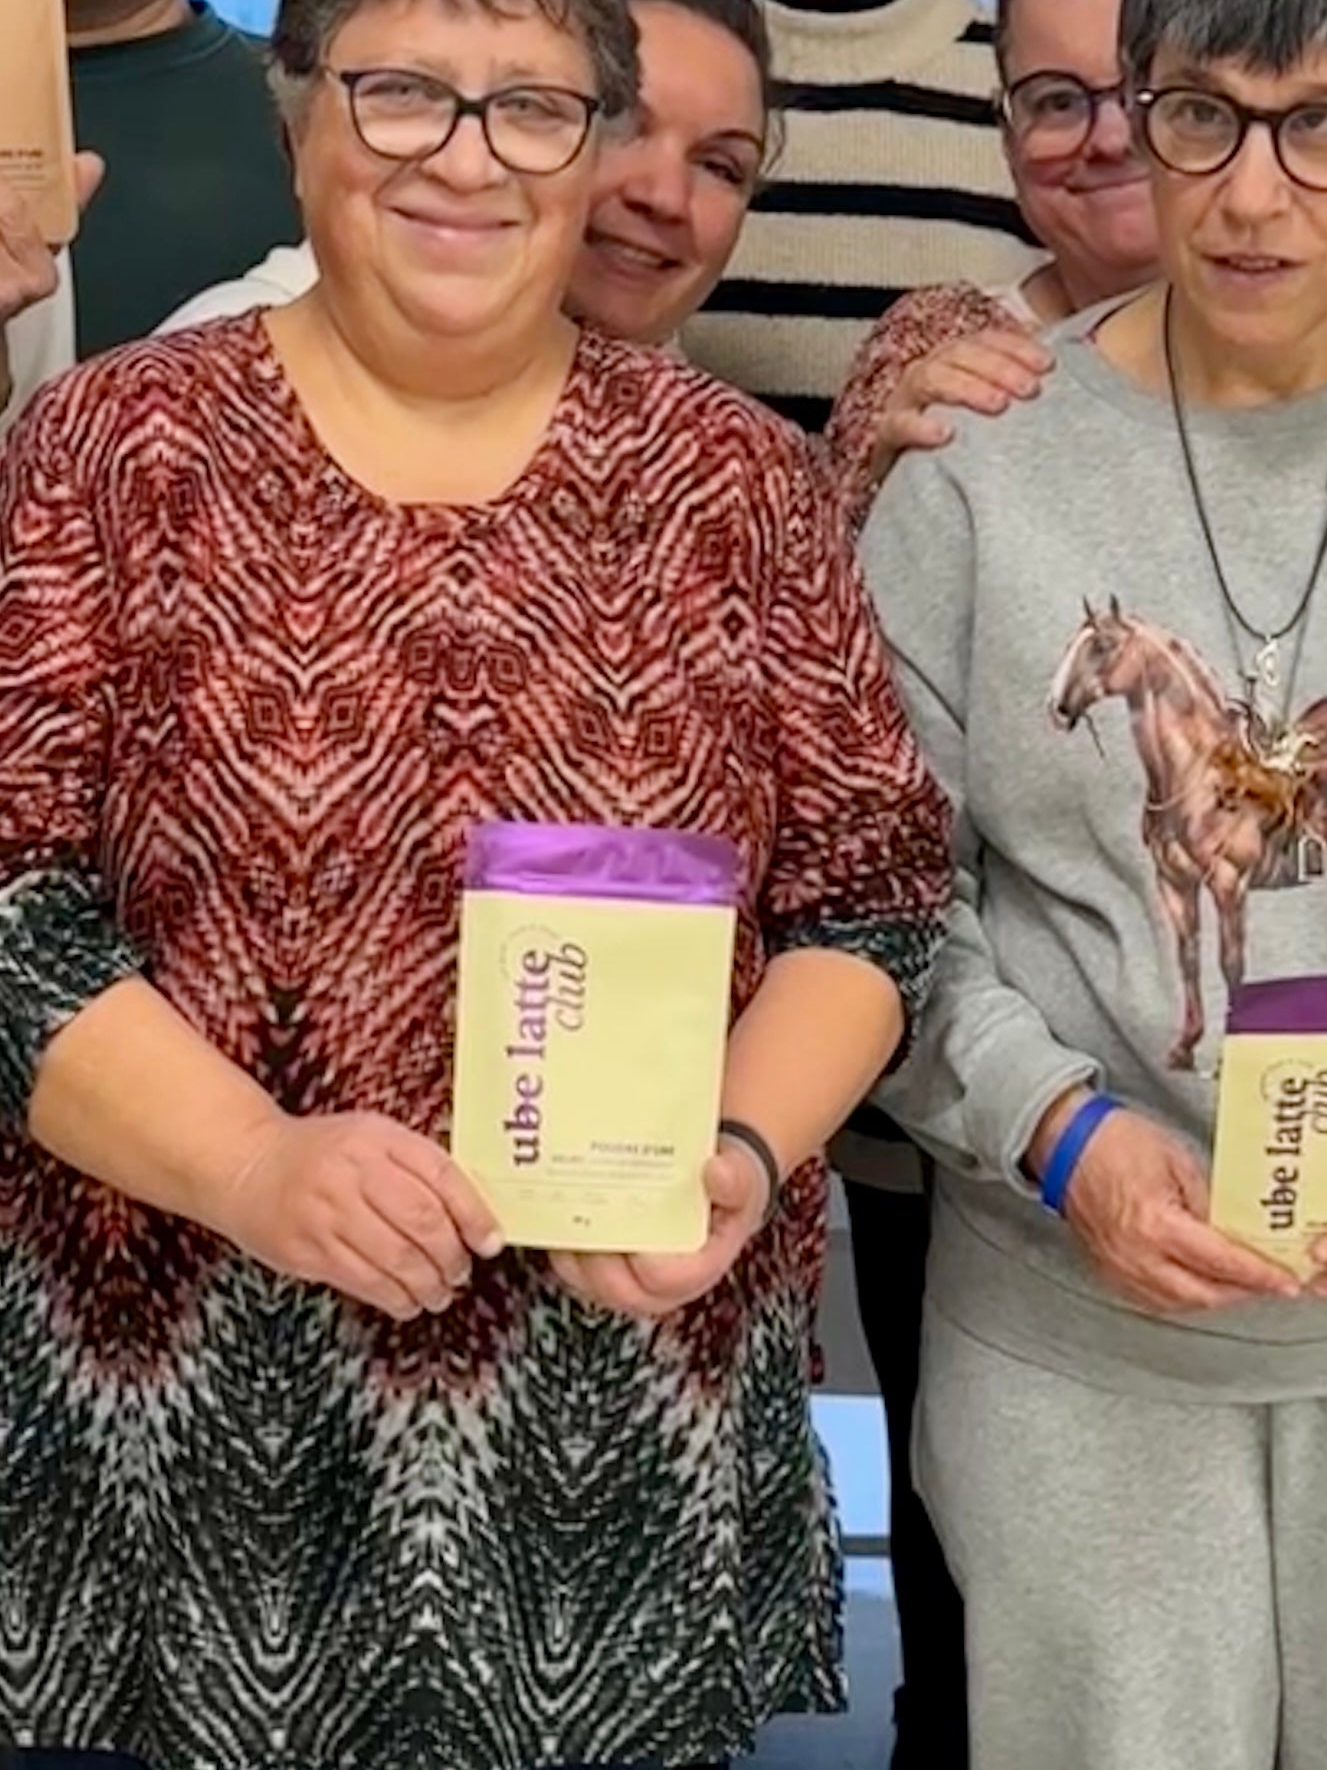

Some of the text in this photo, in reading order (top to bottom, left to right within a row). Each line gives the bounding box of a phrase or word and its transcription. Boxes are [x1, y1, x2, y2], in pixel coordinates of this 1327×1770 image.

[506, 947, 550, 1060] latte
[545, 941, 589, 1032] club
[503, 1072, 545, 1168] ube
[1265, 1076, 1307, 1158] latte
[1260, 1166, 1300, 1232] ube
